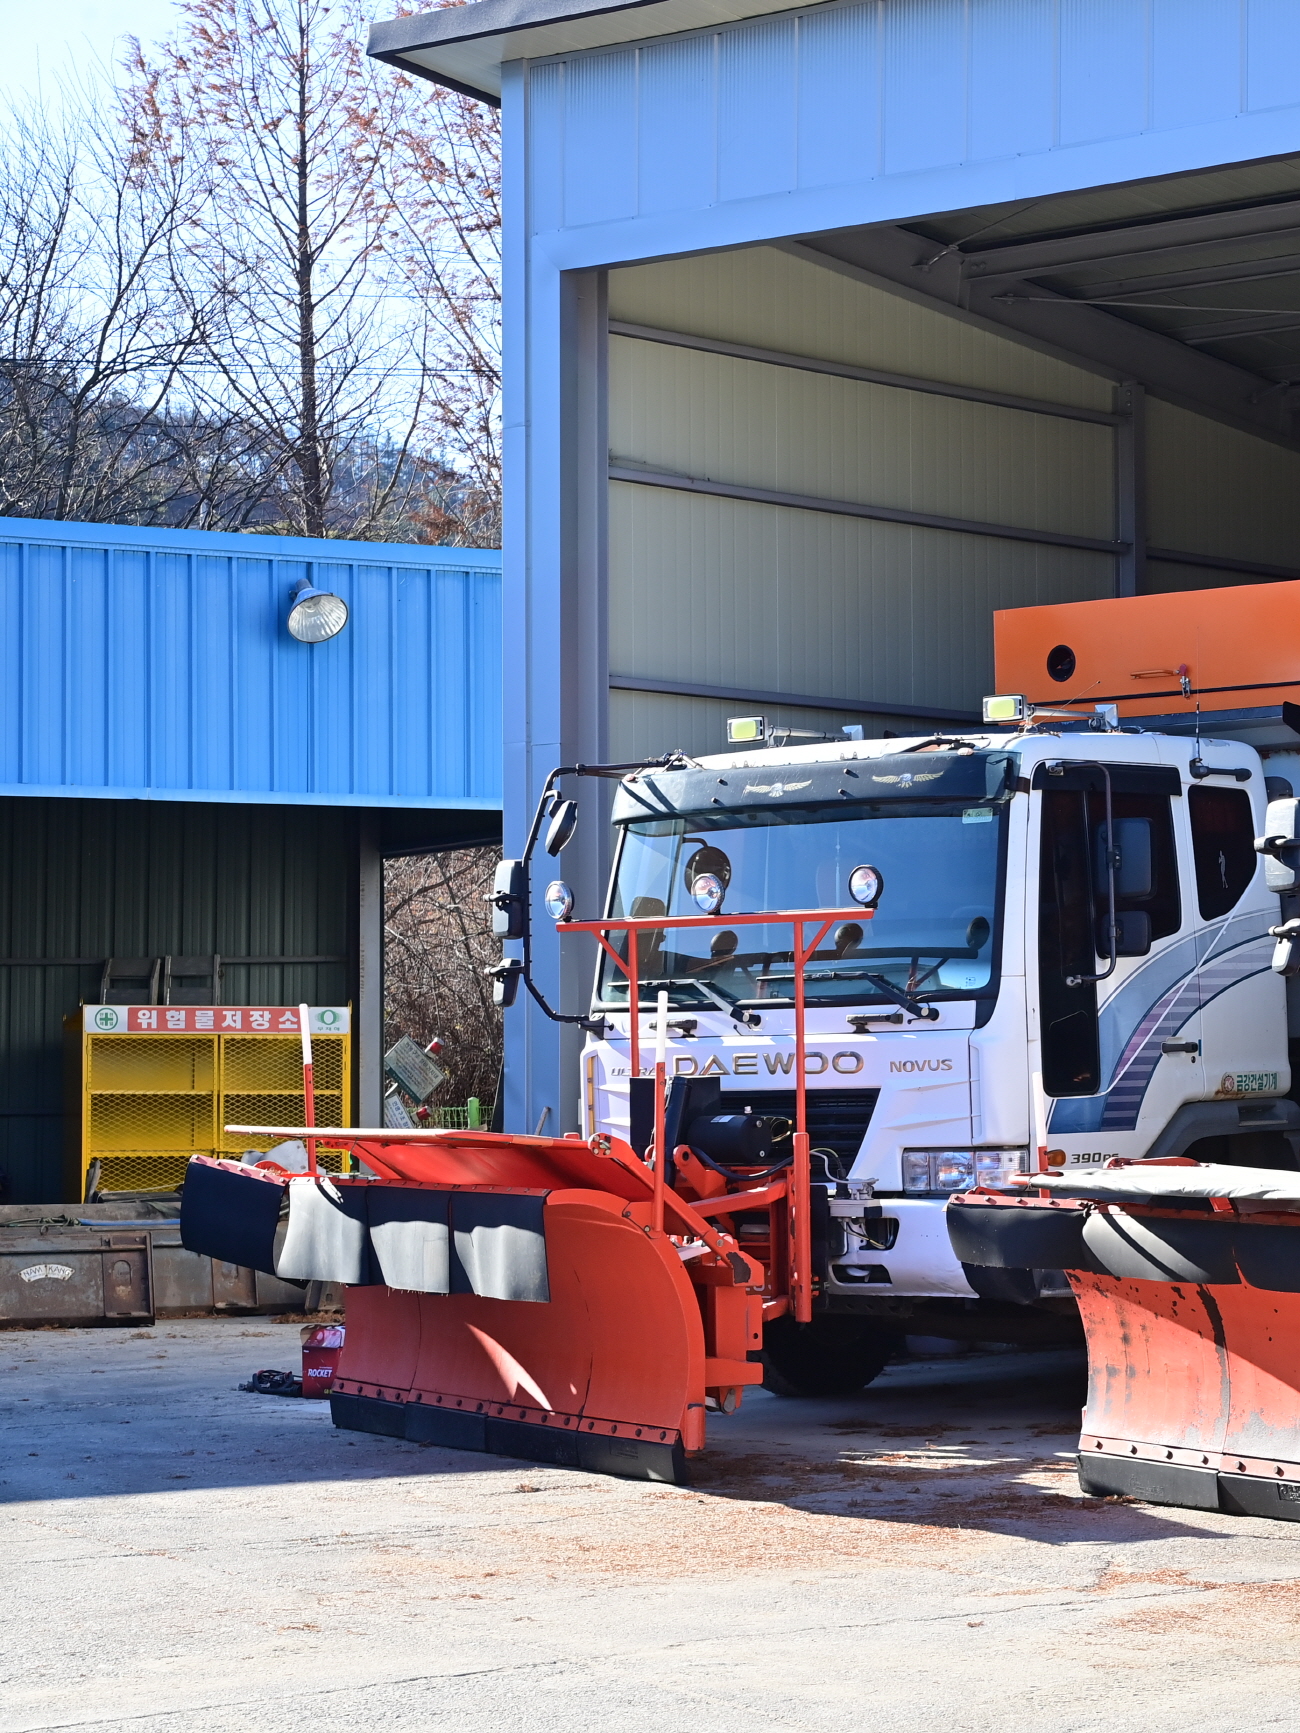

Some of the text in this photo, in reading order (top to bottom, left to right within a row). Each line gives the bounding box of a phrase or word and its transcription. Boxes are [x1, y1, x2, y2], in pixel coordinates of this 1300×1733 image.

[137, 1009, 298, 1029] 위험물저장소
[673, 1051, 953, 1076] DAEWOO NOVUS
[1236, 1072, 1277, 1092] 금강건설기계
[308, 1369, 332, 1377] ROCKET
